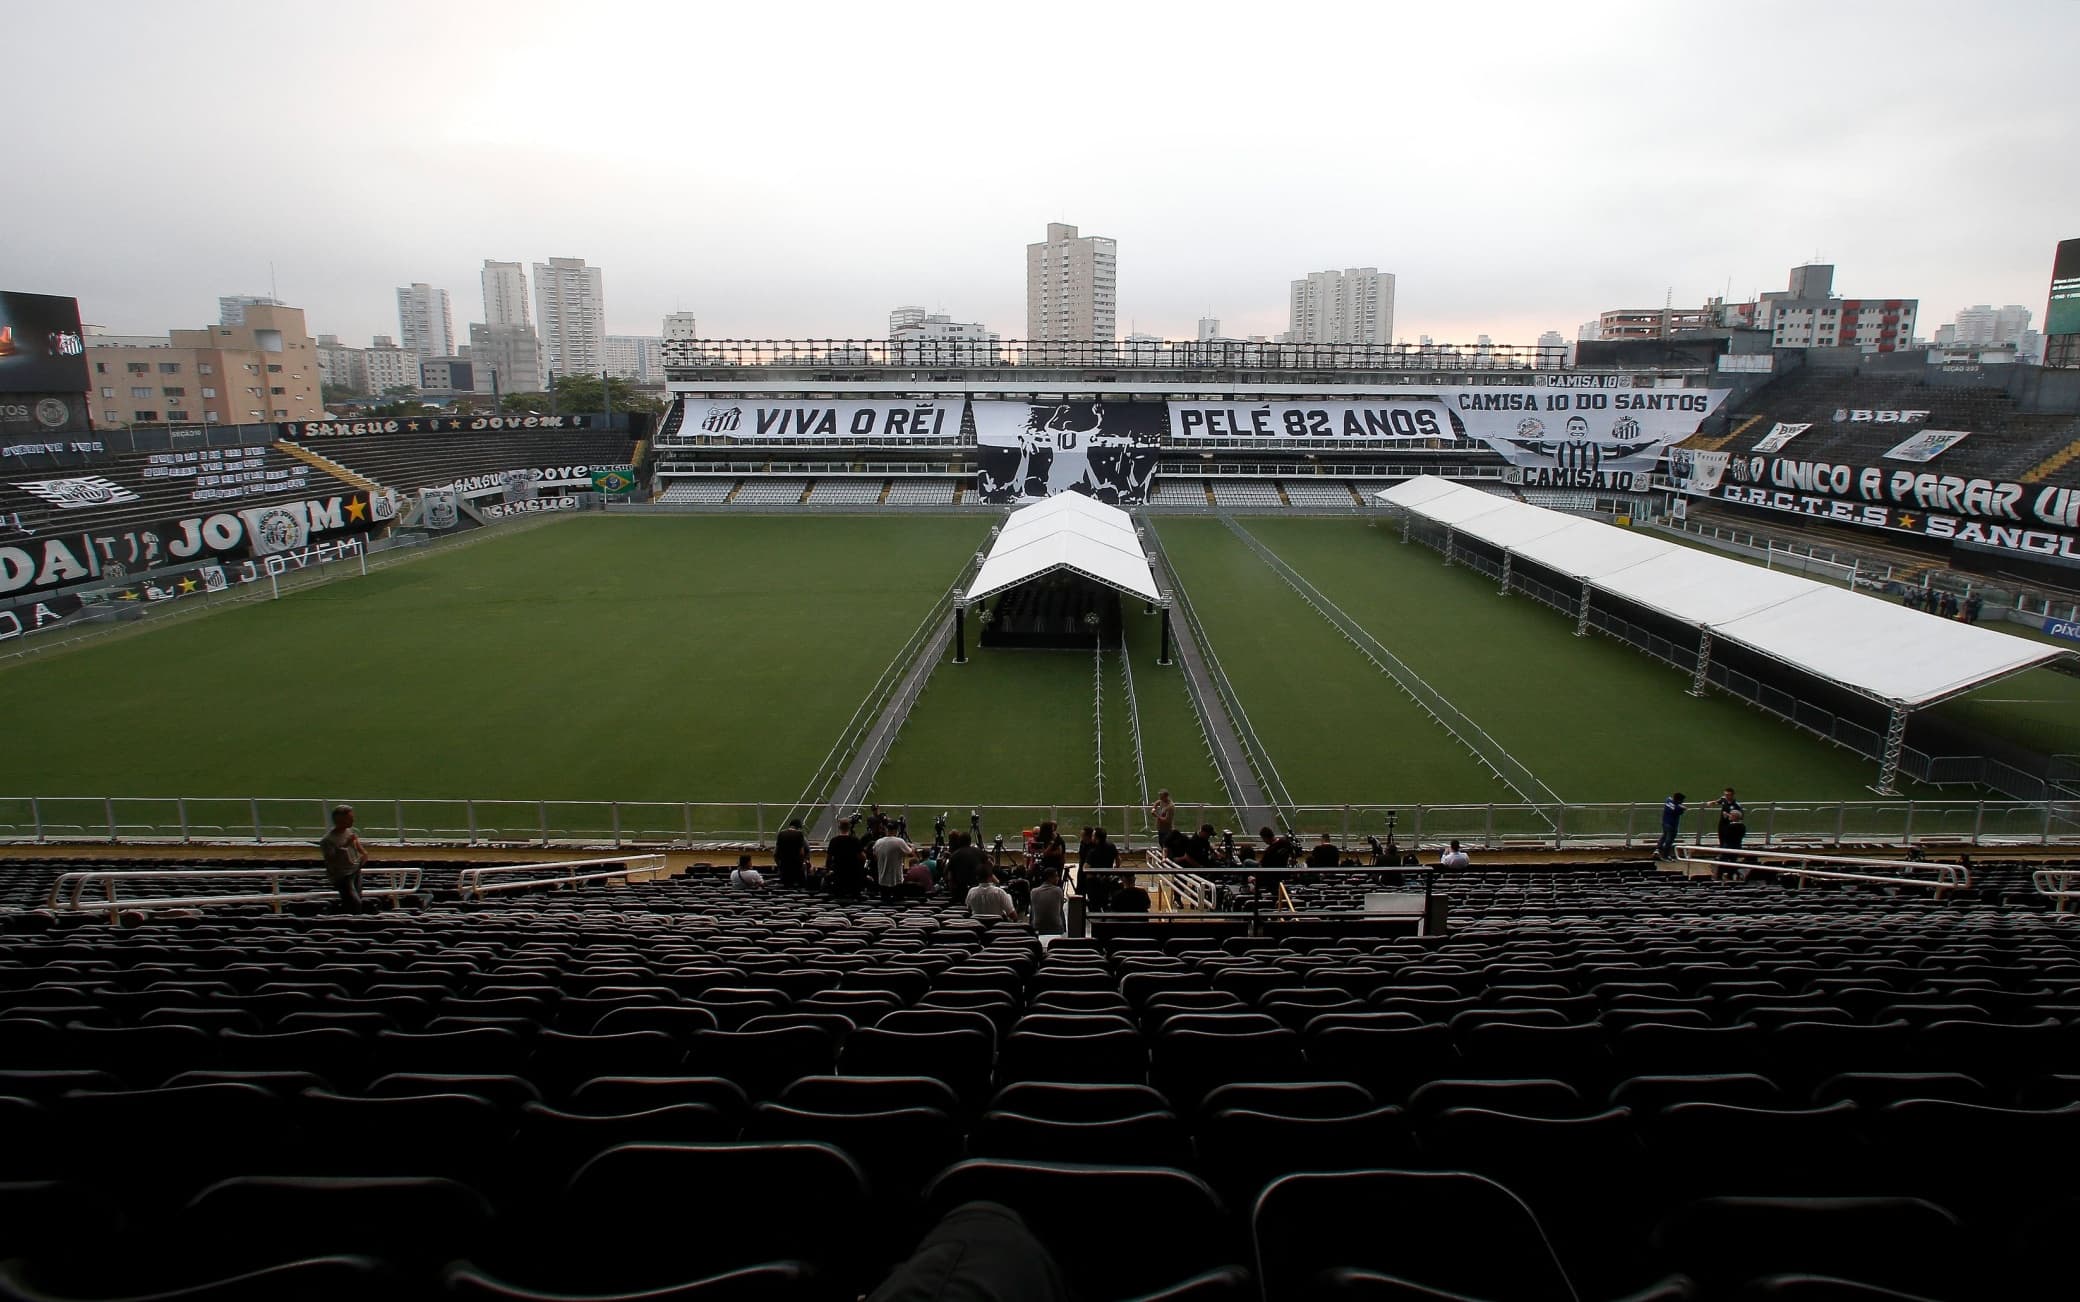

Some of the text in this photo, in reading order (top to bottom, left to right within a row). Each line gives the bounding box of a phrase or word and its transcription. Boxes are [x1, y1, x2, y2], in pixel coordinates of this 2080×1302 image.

[1548, 375, 1618, 388] CAMISA 10
[1458, 393, 1708, 413] CAMISA 10 DO SANTOS
[757, 408, 837, 434] VIVA
[850, 408, 877, 434] O
[1180, 404, 1441, 436] PELÉ 82 ANOS
[1850, 409, 1930, 423] BBF
[1057, 432, 1077, 450] 10
[1522, 466, 1634, 490] CAMISA 10
[1891, 470, 2022, 521] PARAR
[169, 497, 345, 557] JOM
